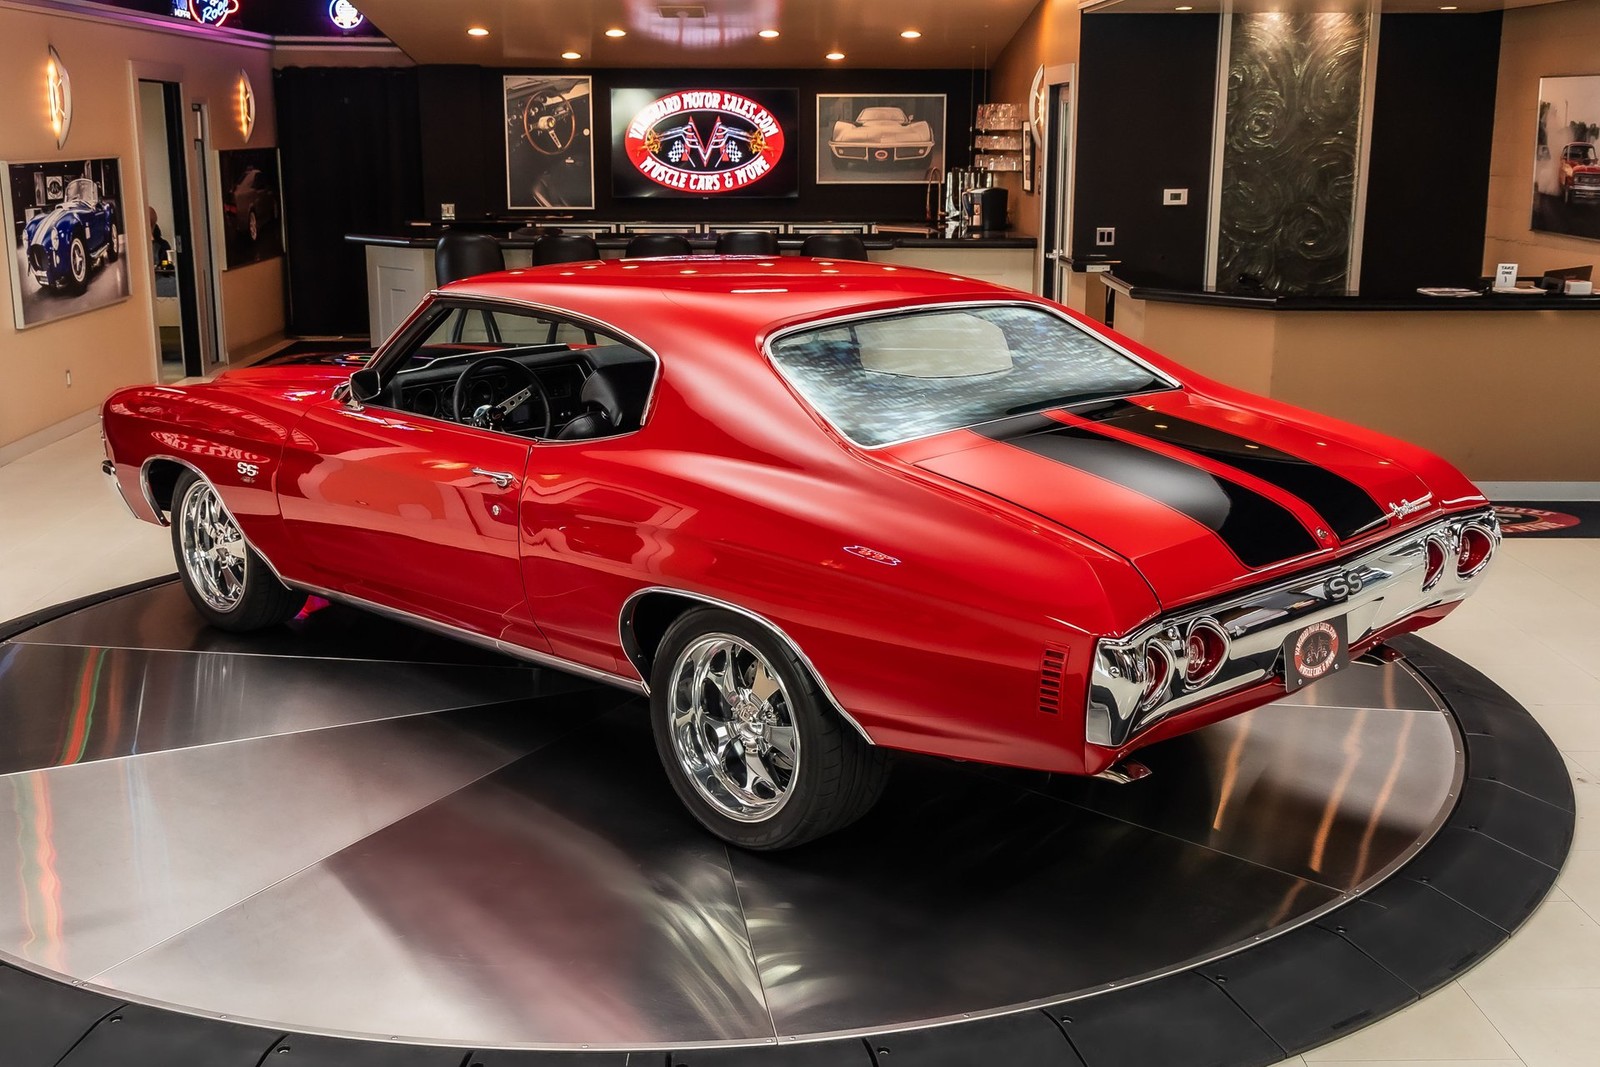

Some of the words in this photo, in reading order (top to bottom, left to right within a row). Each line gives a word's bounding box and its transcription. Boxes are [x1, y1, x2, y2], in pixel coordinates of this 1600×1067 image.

[682, 91, 721, 109] MOTOR
[722, 94, 779, 137] SALES.COM
[639, 156, 689, 188] MUSCLE
[689, 174, 720, 191] CARS
[724, 173, 734, 188] &
[734, 156, 771, 186] MORE
[237, 461, 259, 477] SS
[1326, 571, 1363, 600] SS
